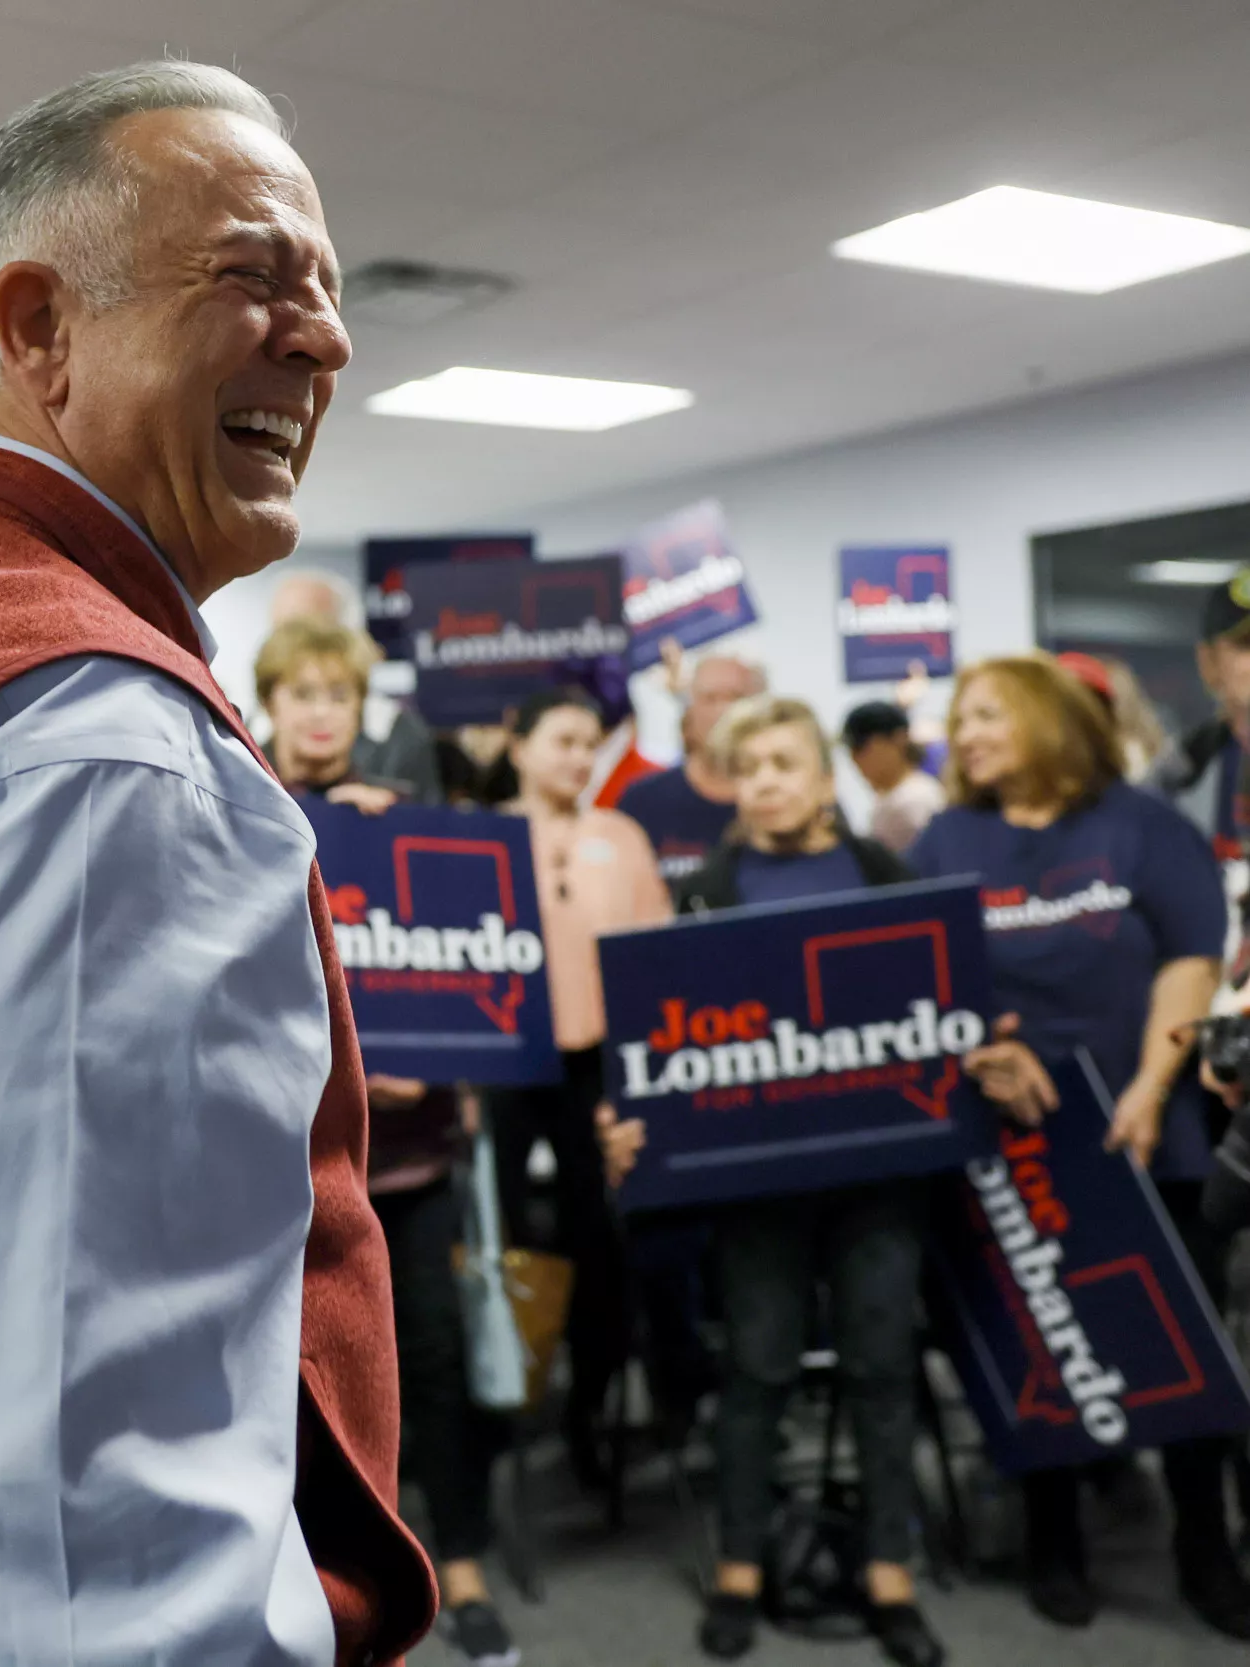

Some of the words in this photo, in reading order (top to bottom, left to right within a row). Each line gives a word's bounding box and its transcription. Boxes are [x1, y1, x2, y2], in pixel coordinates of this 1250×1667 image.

[617, 998, 985, 1098] Lombardo
[648, 998, 769, 1051] Joe
[964, 1151, 1129, 1444] ombardo
